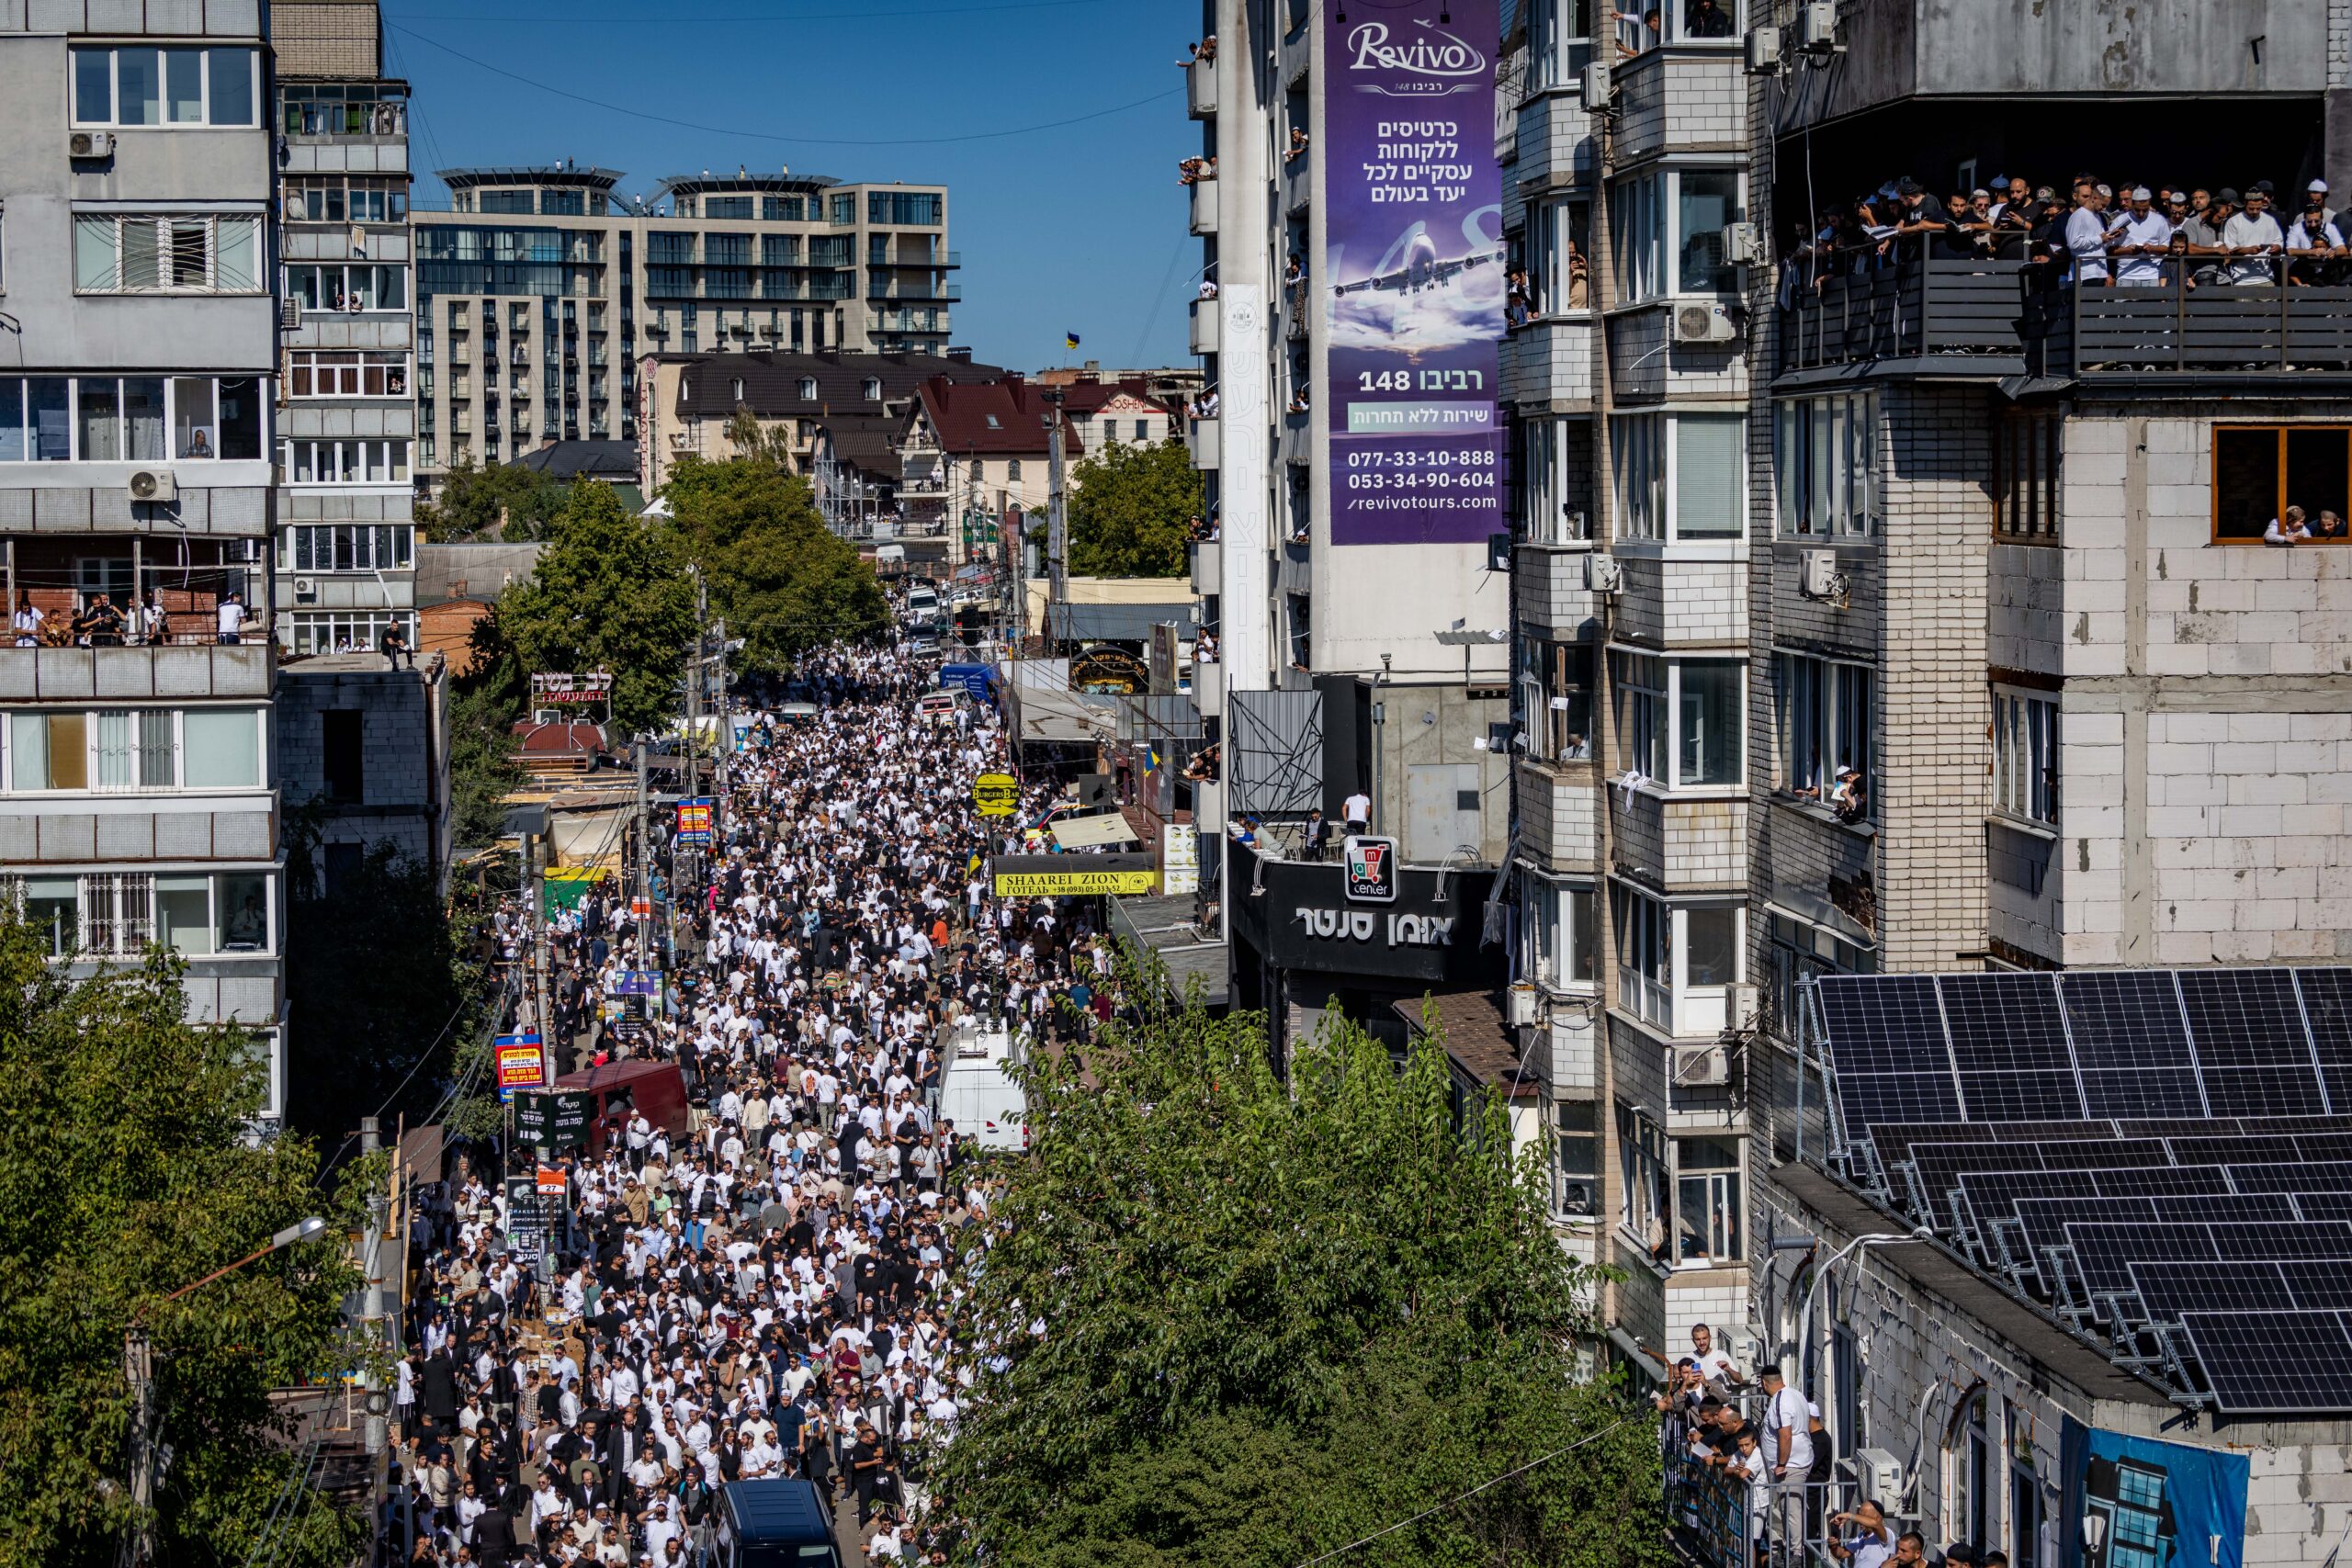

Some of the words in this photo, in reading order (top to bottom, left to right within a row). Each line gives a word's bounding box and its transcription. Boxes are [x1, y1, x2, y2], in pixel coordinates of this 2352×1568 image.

[1348, 22, 1467, 71] Revivo
[1377, 121, 1458, 138] כרטיסים
[1377, 141, 1459, 163] ללקוחות
[1363, 163, 1398, 181] לכל
[1404, 164, 1473, 184] עסקיים
[1371, 185, 1430, 203] בעולם
[1433, 186, 1466, 202] יעד
[1358, 371, 1411, 391] 148
[1419, 369, 1483, 390] רביבו
[1353, 410, 1404, 424] תחרות
[1408, 408, 1439, 423] ללא
[1442, 409, 1488, 423] שירות
[1348, 451, 1495, 468] 077-33-10-888
[1348, 472, 1495, 489] 053-34-90-604
[1006, 874, 1072, 886] SHAAREI
[1081, 874, 1120, 885] ZION
[1006, 886, 1049, 895] ГОТЕЛЬ
[1053, 886, 1066, 894] +38
[1067, 886, 1084, 895] (093)
[1086, 885, 1121, 894] 05-333-52
[1354, 884, 1388, 896] center
[1295, 908, 1376, 941] סנטר
[1388, 913, 1456, 946] אומן
